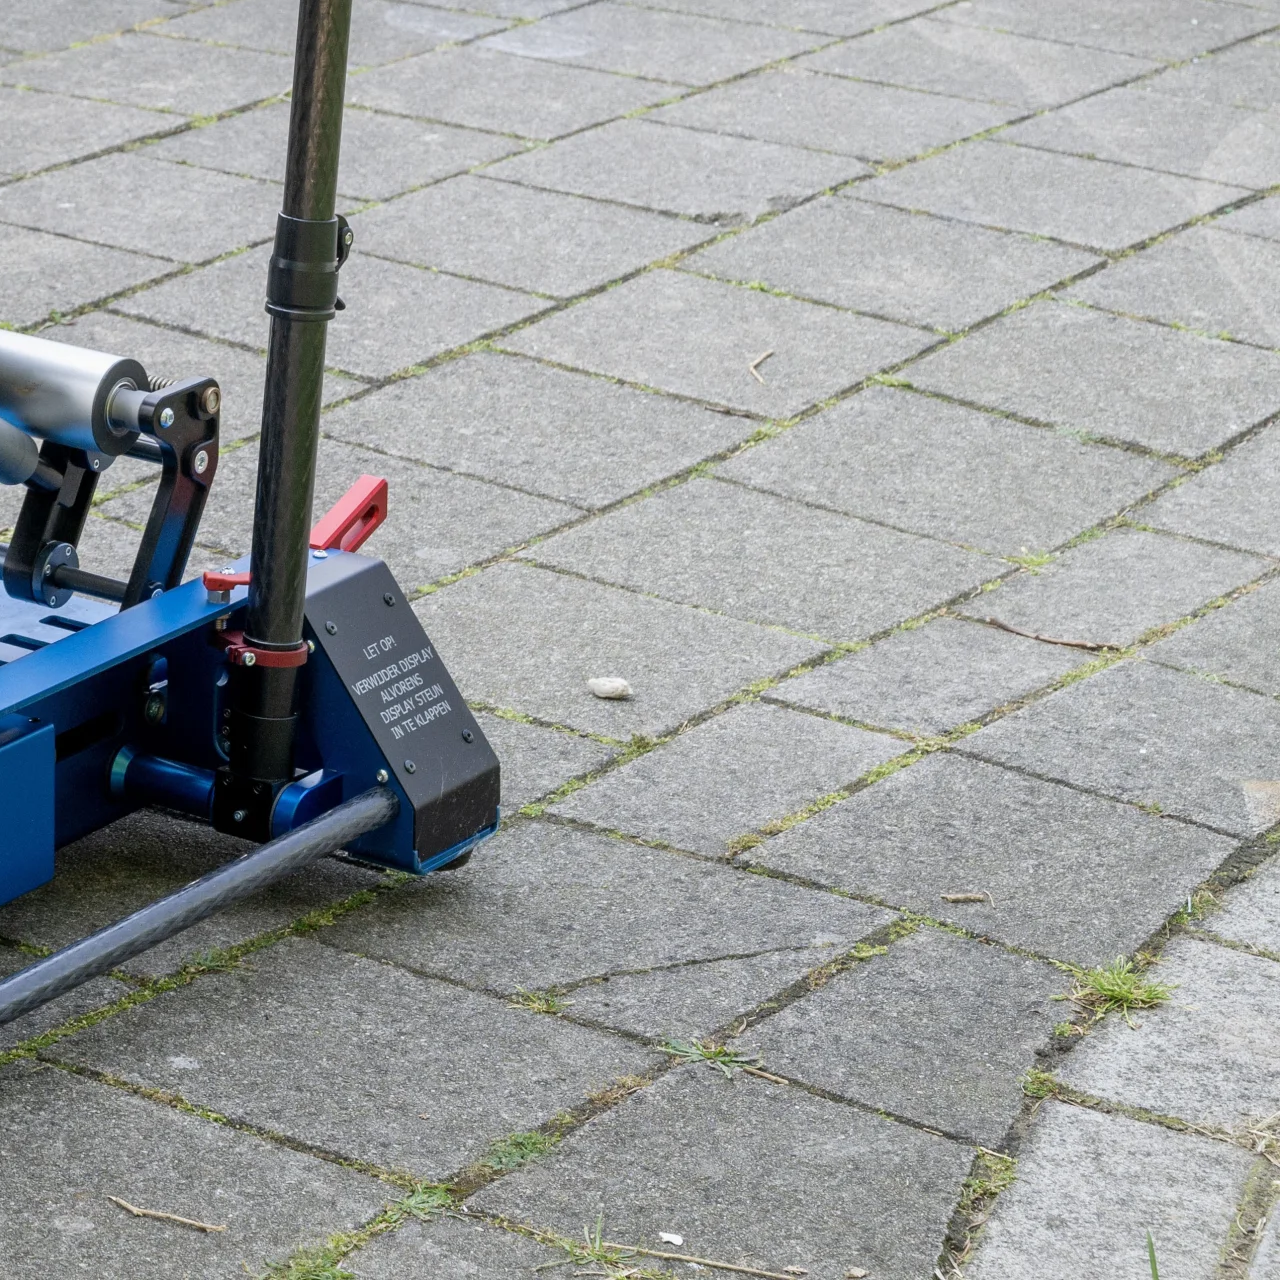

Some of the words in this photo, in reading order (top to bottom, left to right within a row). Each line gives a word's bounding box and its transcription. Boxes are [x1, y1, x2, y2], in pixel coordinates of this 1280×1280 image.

[362, 642, 381, 660] LET
[379, 634, 398, 652] OP!
[351, 663, 402, 696] VERWIJDER
[398, 645, 434, 673] DISPLAY
[380, 672, 424, 704] ALVORENS
[379, 696, 416, 725] DISPLAY
[414, 682, 444, 707] STEUN
[390, 726, 405, 740] IN
[401, 718, 417, 733] TE
[413, 700, 452, 728] KLAPPEN
